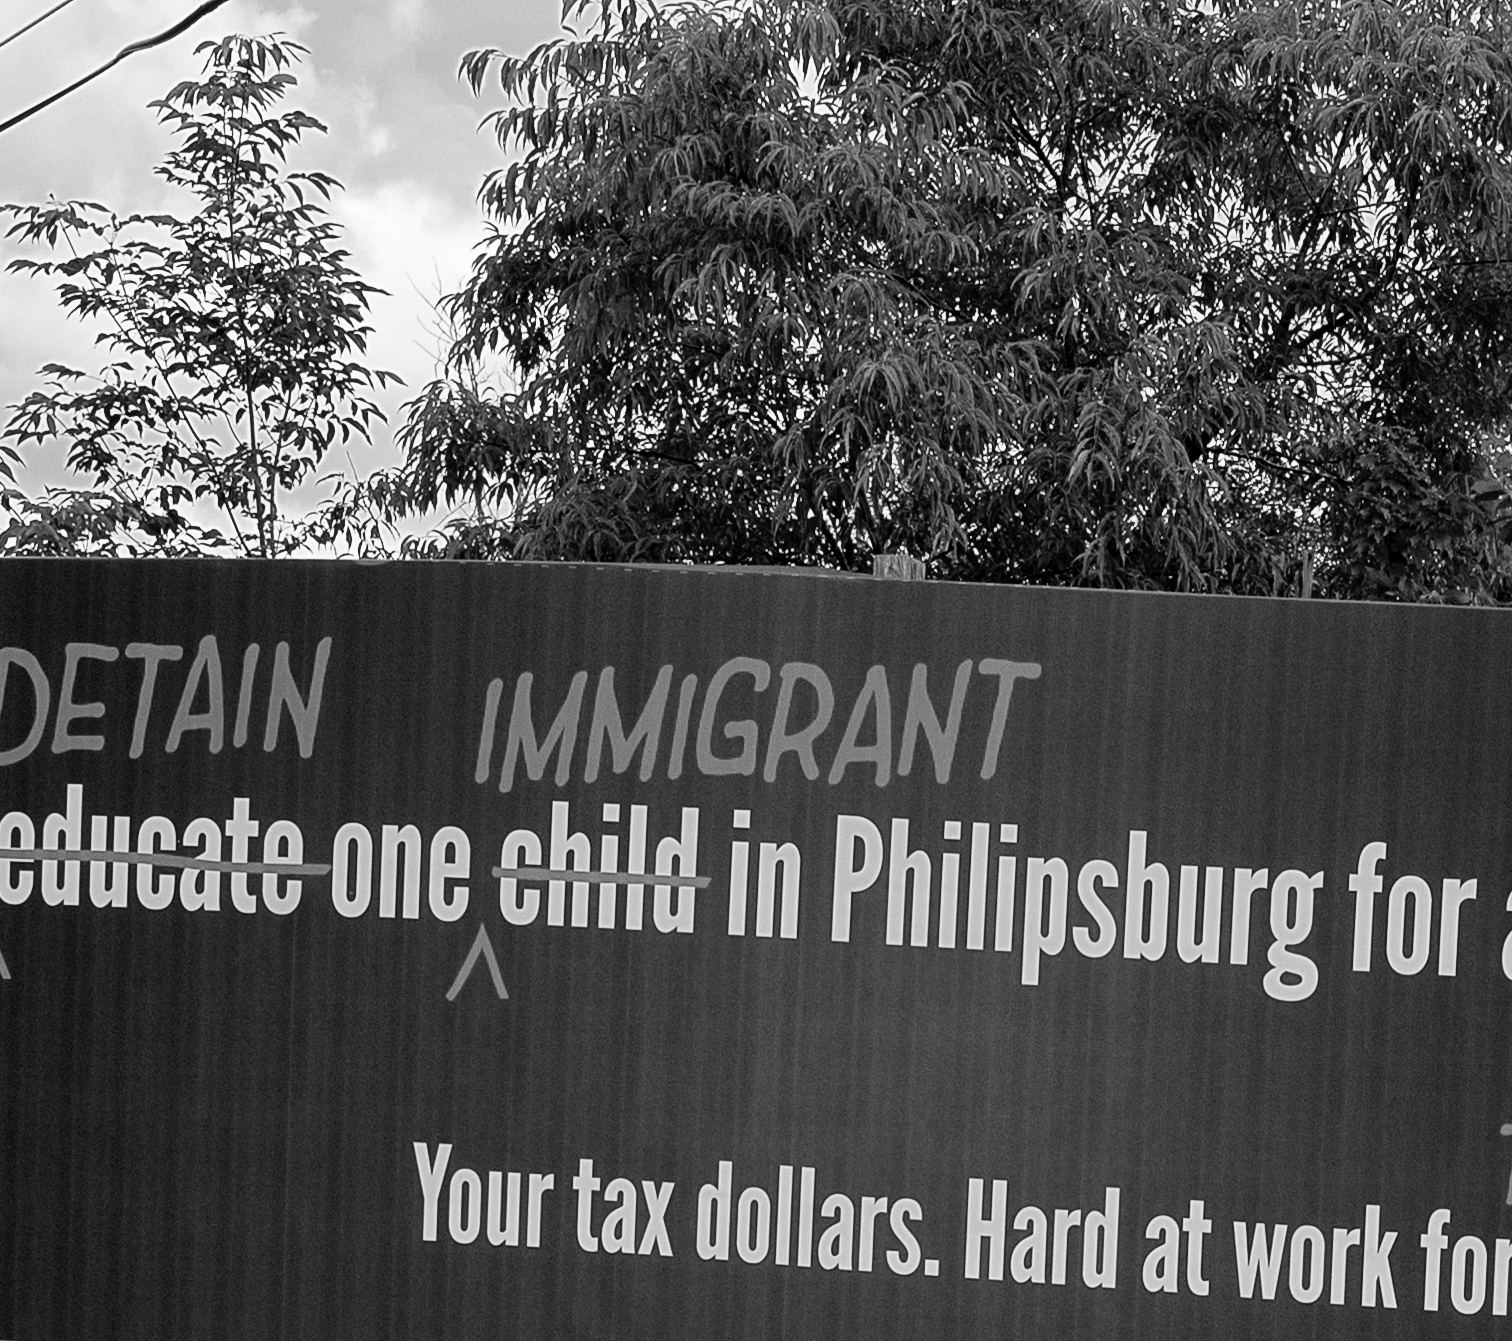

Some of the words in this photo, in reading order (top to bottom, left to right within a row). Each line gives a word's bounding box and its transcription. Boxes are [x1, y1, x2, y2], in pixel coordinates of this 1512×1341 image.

[475, 656, 1043, 793] IMMIGRANT
[332, 822, 470, 921] one
[500, 801, 699, 932] child
[728, 809, 800, 938] in
[832, 815, 1323, 1001] Philipsburg
[1349, 841, 1477, 976] for
[414, 1141, 555, 1248] Your
[574, 1155, 673, 1256] tax
[697, 1161, 939, 1275] dollars.
[965, 1178, 1120, 1287] Hard
[1143, 1200, 1212, 1295] at
[1234, 1204, 1397, 1307] work
